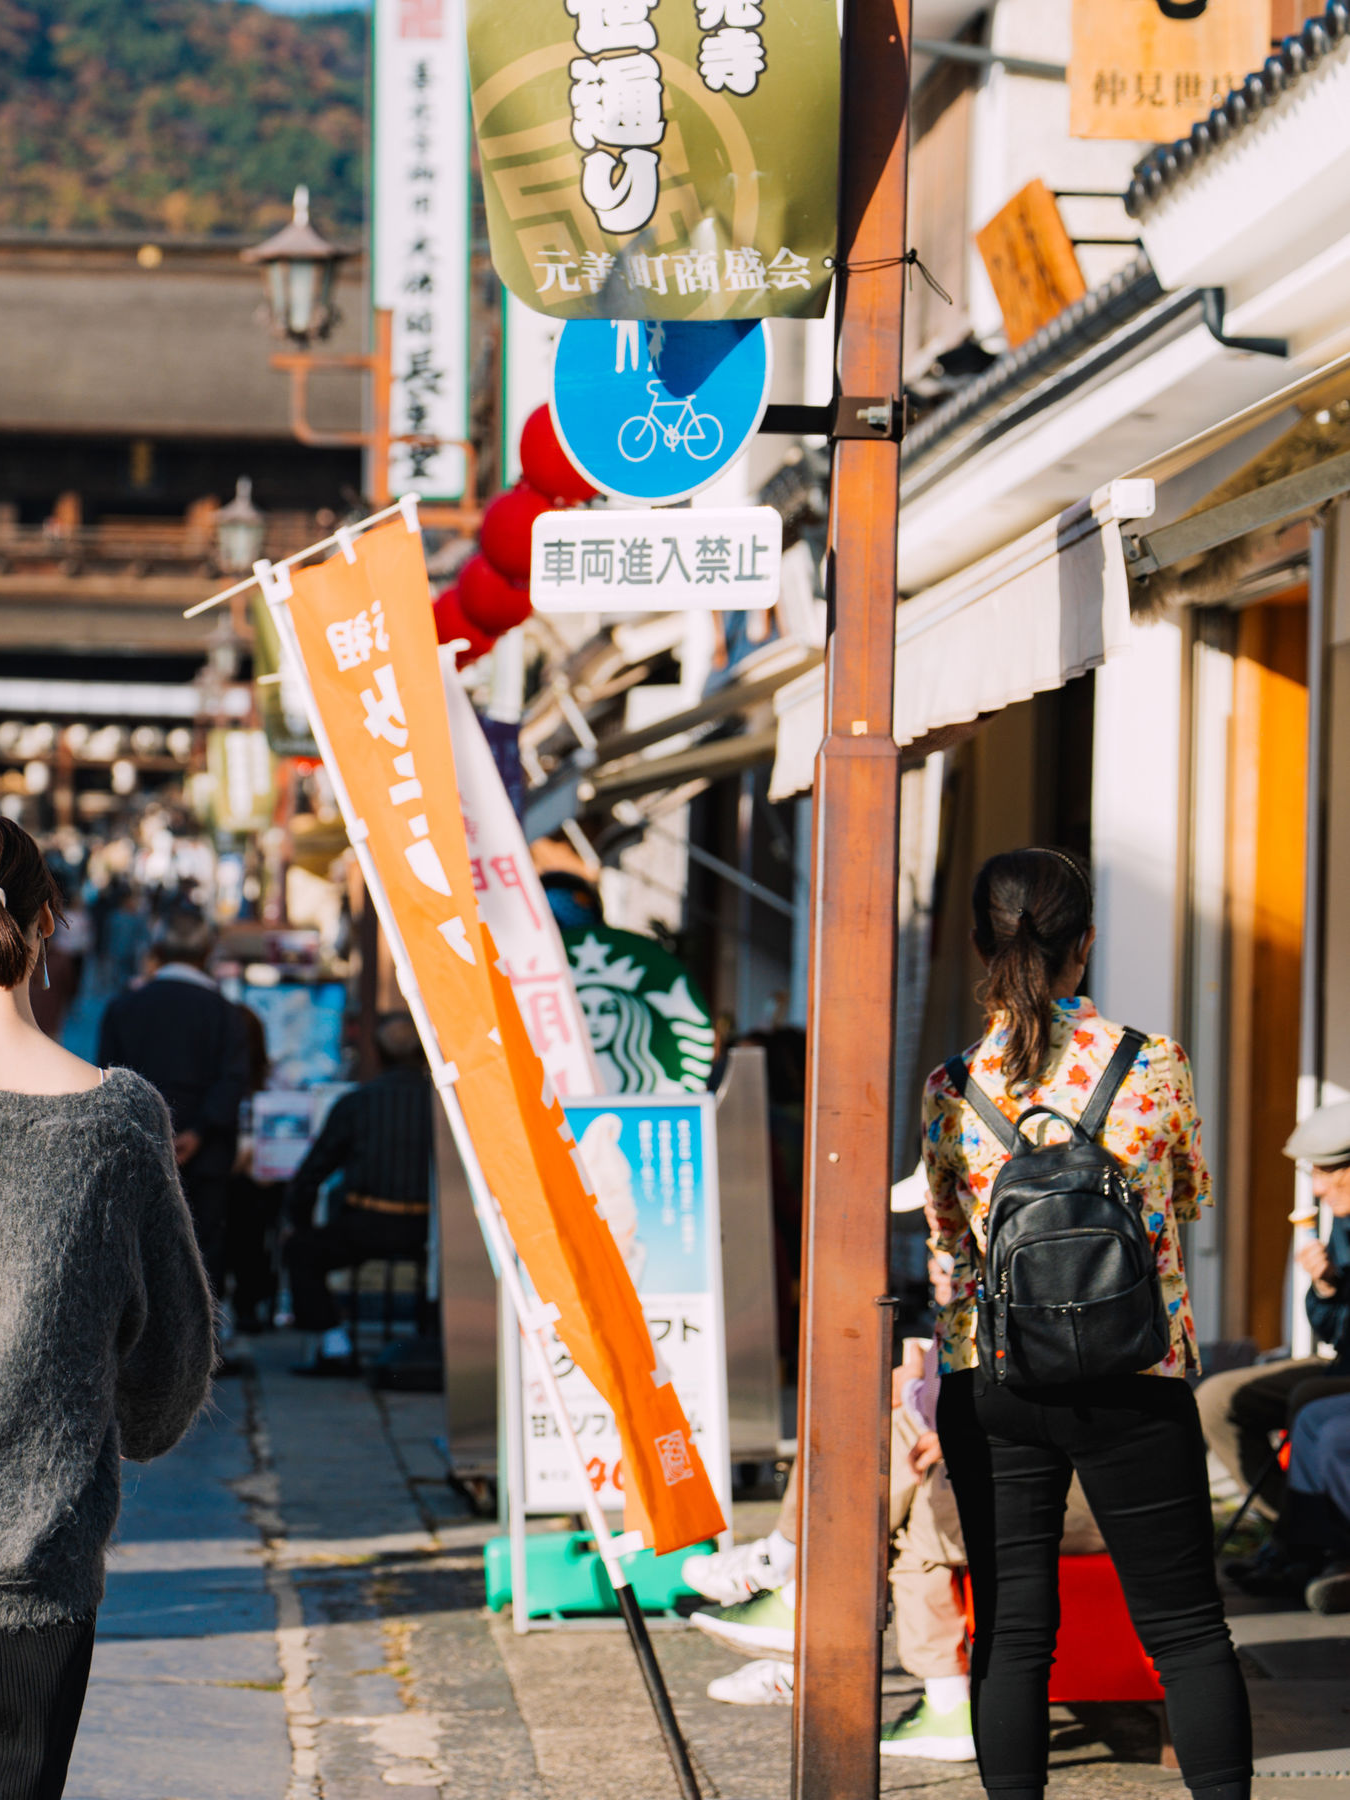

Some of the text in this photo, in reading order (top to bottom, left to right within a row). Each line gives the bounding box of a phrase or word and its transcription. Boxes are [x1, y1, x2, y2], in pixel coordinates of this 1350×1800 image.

[541, 534, 771, 587] 車両進入禁止
